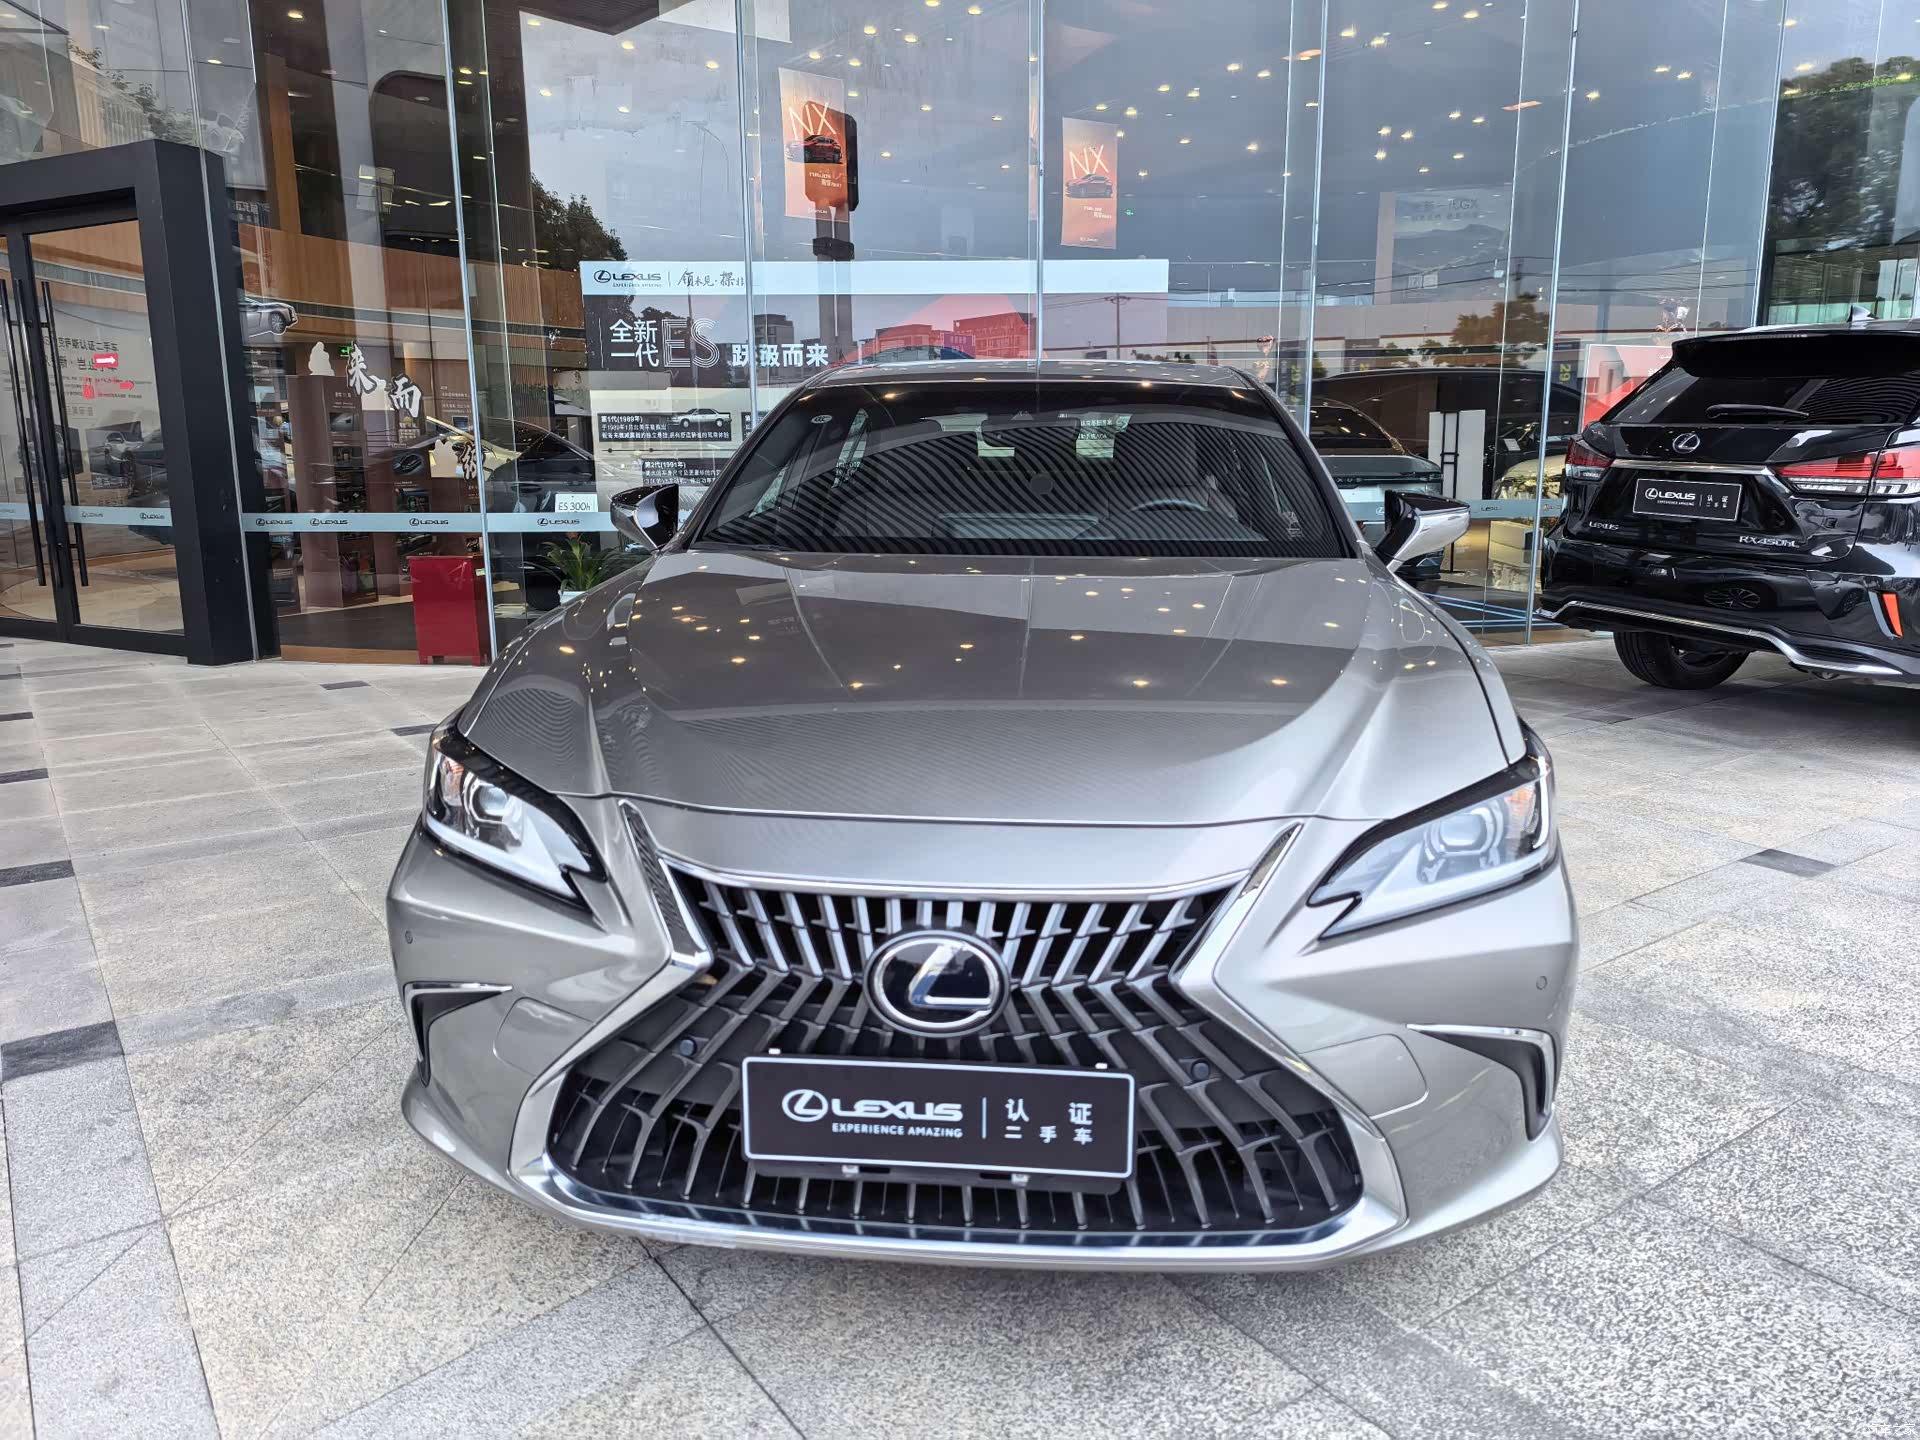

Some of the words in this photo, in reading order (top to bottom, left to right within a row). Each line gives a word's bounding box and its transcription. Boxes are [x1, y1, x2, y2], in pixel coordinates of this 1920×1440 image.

[788, 102, 837, 141] NX
[1069, 144, 1110, 180] NX
[612, 273, 662, 281] LEXUS
[609, 319, 658, 343] 全新
[661, 317, 720, 368] ES
[610, 344, 660, 368] 一代
[558, 502, 569, 511] ES
[570, 502, 592, 511] 300h
[1658, 491, 1696, 500] LEXUS
[1589, 521, 1619, 531] LEXUS
[831, 1098, 964, 1122] LEXUS
[832, 1122, 905, 1136] EXPERIENCE
[907, 1125, 964, 1139] AMAZING
